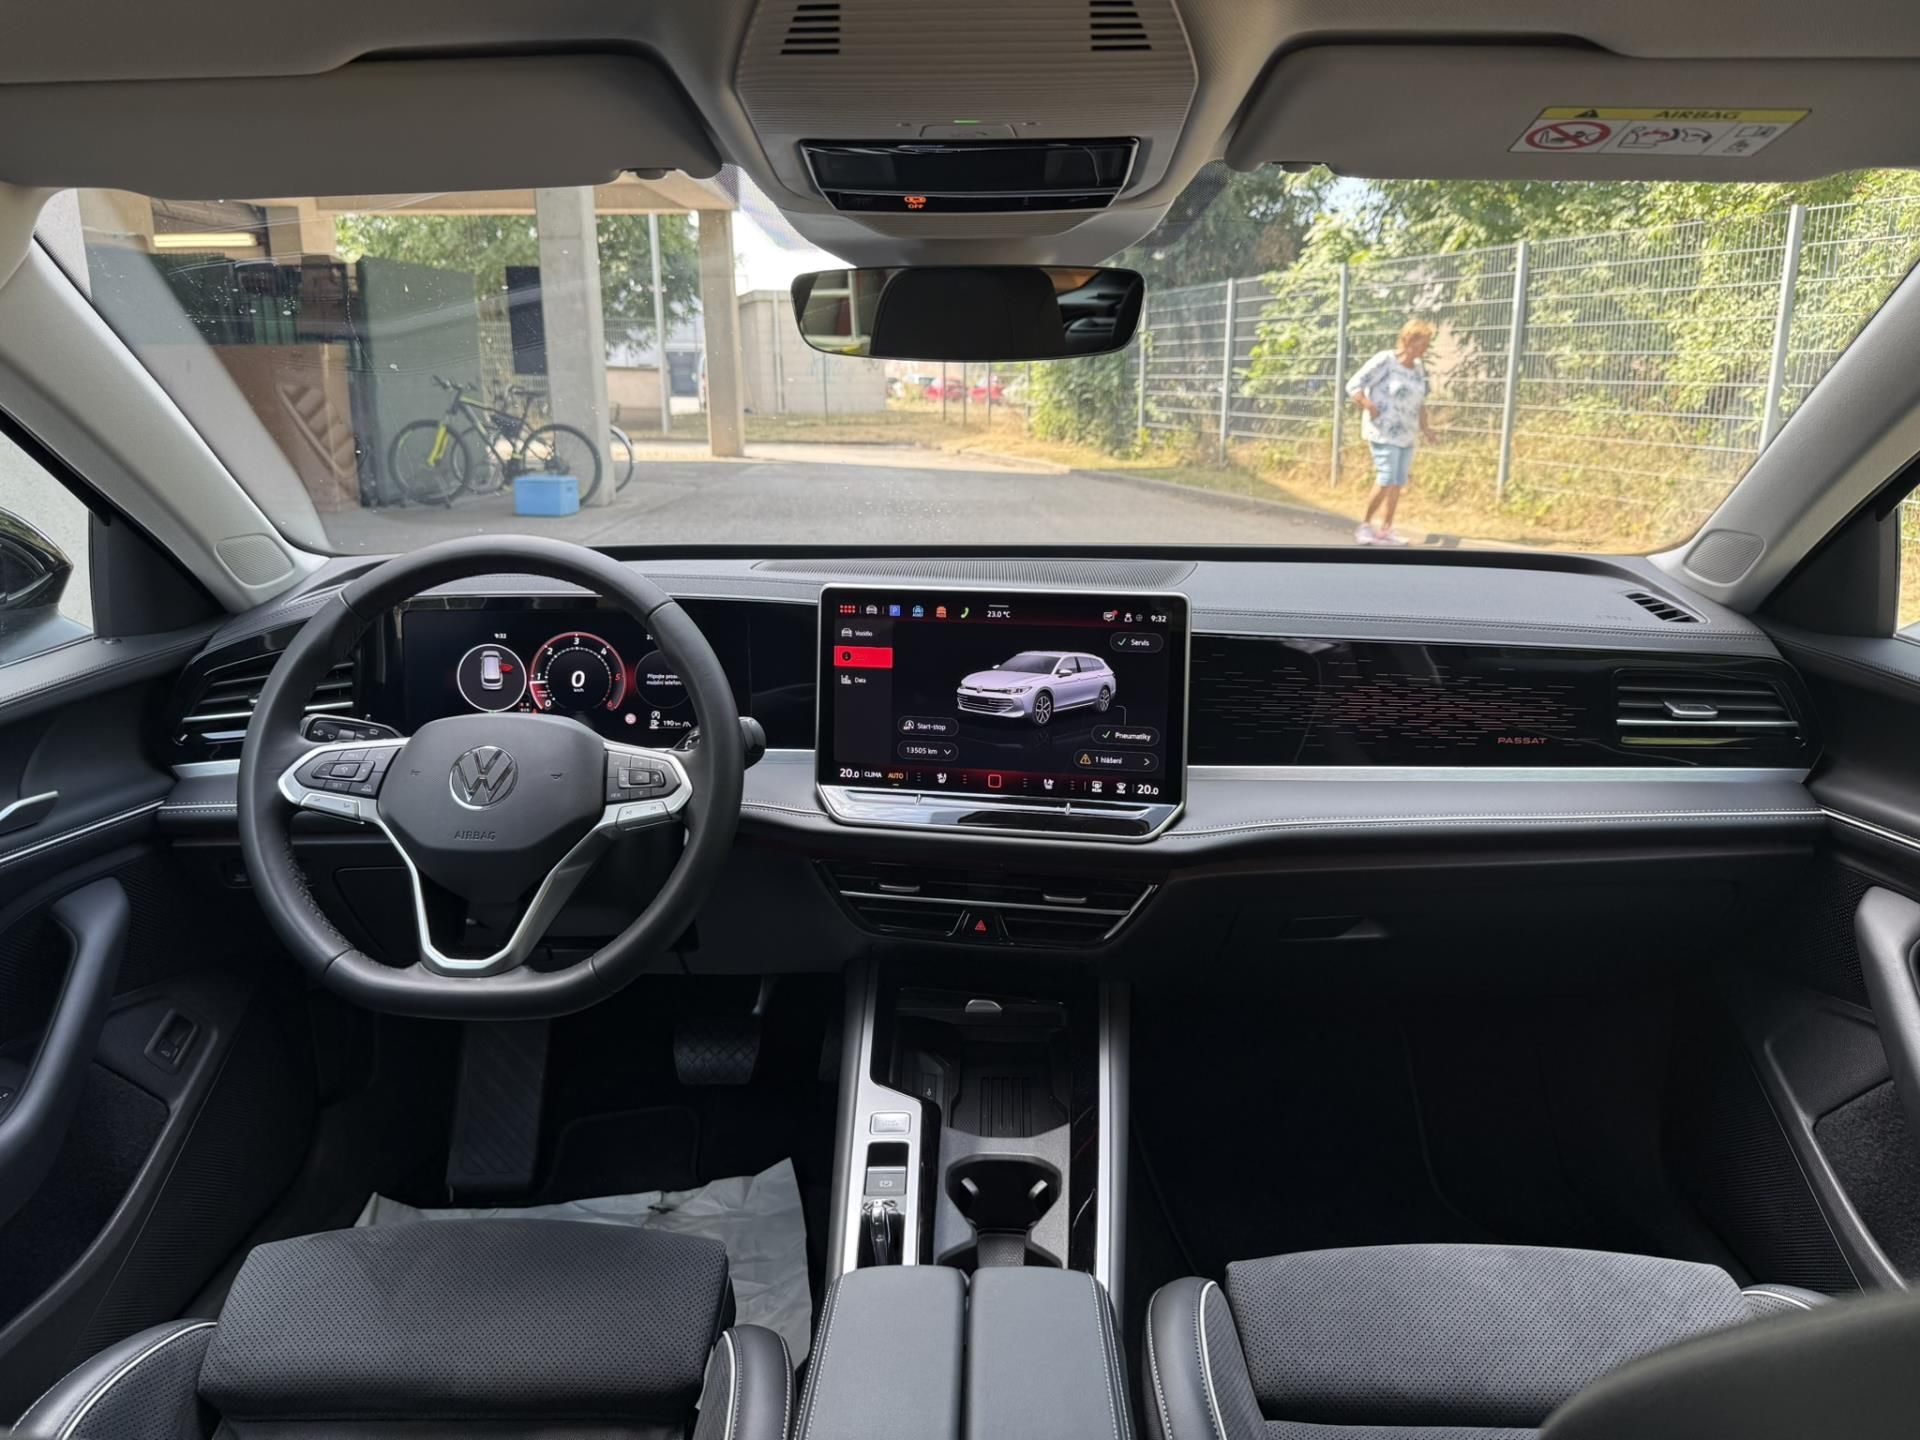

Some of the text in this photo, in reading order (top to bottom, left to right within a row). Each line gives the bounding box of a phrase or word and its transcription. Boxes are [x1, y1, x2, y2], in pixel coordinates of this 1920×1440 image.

[1654, 109, 1741, 120] AIRBAG
[1150, 614, 1167, 623] 9:32
[573, 637, 580, 645] 3
[1130, 637, 1150, 647] Servis
[546, 647, 553, 655] 2
[571, 670, 586, 688] 0
[855, 676, 866, 684] Data
[917, 722, 947, 732] Start-stop
[1497, 736, 1547, 745] PASSAT
[906, 746, 927, 755] 13505
[839, 768, 904, 780] 20.0 CLIMA AUTO
[1137, 784, 1160, 796] 20.0
[454, 831, 496, 840] AIRBAG
